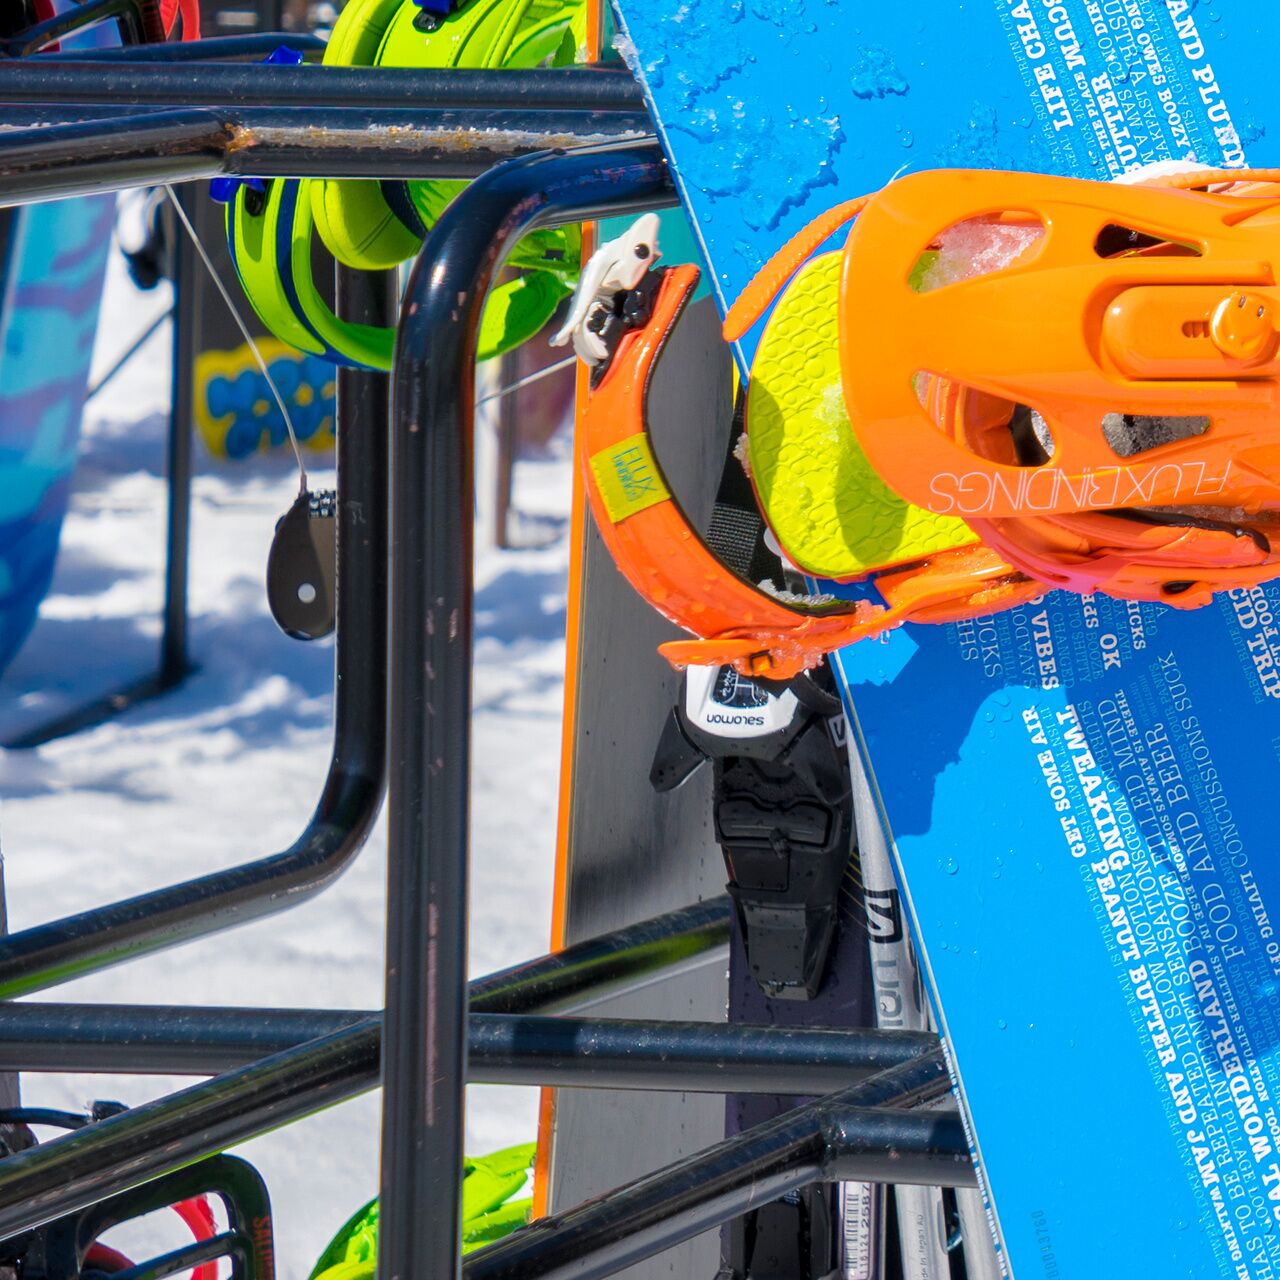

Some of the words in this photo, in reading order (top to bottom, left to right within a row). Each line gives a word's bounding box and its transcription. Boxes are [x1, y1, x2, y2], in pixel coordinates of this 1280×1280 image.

[1032, 63, 1073, 132] LIFE
[1072, 71, 1098, 118] PLACE
[1135, 31, 1166, 86] OWES
[1156, 88, 1190, 150] BOOZY
[1091, 119, 1111, 154] THE
[1247, 586, 1277, 639] FOOD
[1030, 610, 1060, 692] VIBES
[1098, 631, 1122, 673] OK
[1156, 651, 1192, 712] SUCK
[706, 713, 764, 726] salomon
[1019, 705, 1047, 748] AIR
[1095, 697, 1135, 768] MIND
[1036, 749, 1070, 813] SOME
[1053, 703, 1131, 873] TWEAKING
[1075, 699, 1120, 794] SLURRING
[1110, 796, 1145, 862] WORDS
[1142, 722, 1189, 805] BEER
[1179, 715, 1249, 870] CONCUSSIONS
[1059, 814, 1087, 859] GET
[1123, 773, 1170, 866] FILLED
[1174, 809, 1215, 876] AND
[1116, 872, 1158, 956] MOTION
[1132, 859, 1189, 987] SENSATION
[1158, 871, 1202, 953] BOOZE
[1199, 881, 1246, 962] FOOD
[1239, 871, 1273, 939] LIVING
[1089, 858, 1140, 963] PEANUT
[1127, 964, 1178, 1067] BUTTER
[1164, 1068, 1198, 1125] AND
[1185, 1126, 1221, 1188] JAM
[1147, 959, 1181, 1020] SLOW
[1169, 1023, 1191, 1048] IN
[1178, 989, 1232, 1106] INTERNET
[1186, 958, 1273, 1163] WONDERLAND
[1179, 1051, 1233, 1166] REPEATED
[1222, 1170, 1244, 1199] BE
[1234, 1203, 1257, 1234] TO
[1207, 1187, 1243, 1262] WALKING
[1245, 1236, 1273, 1280] HAS
